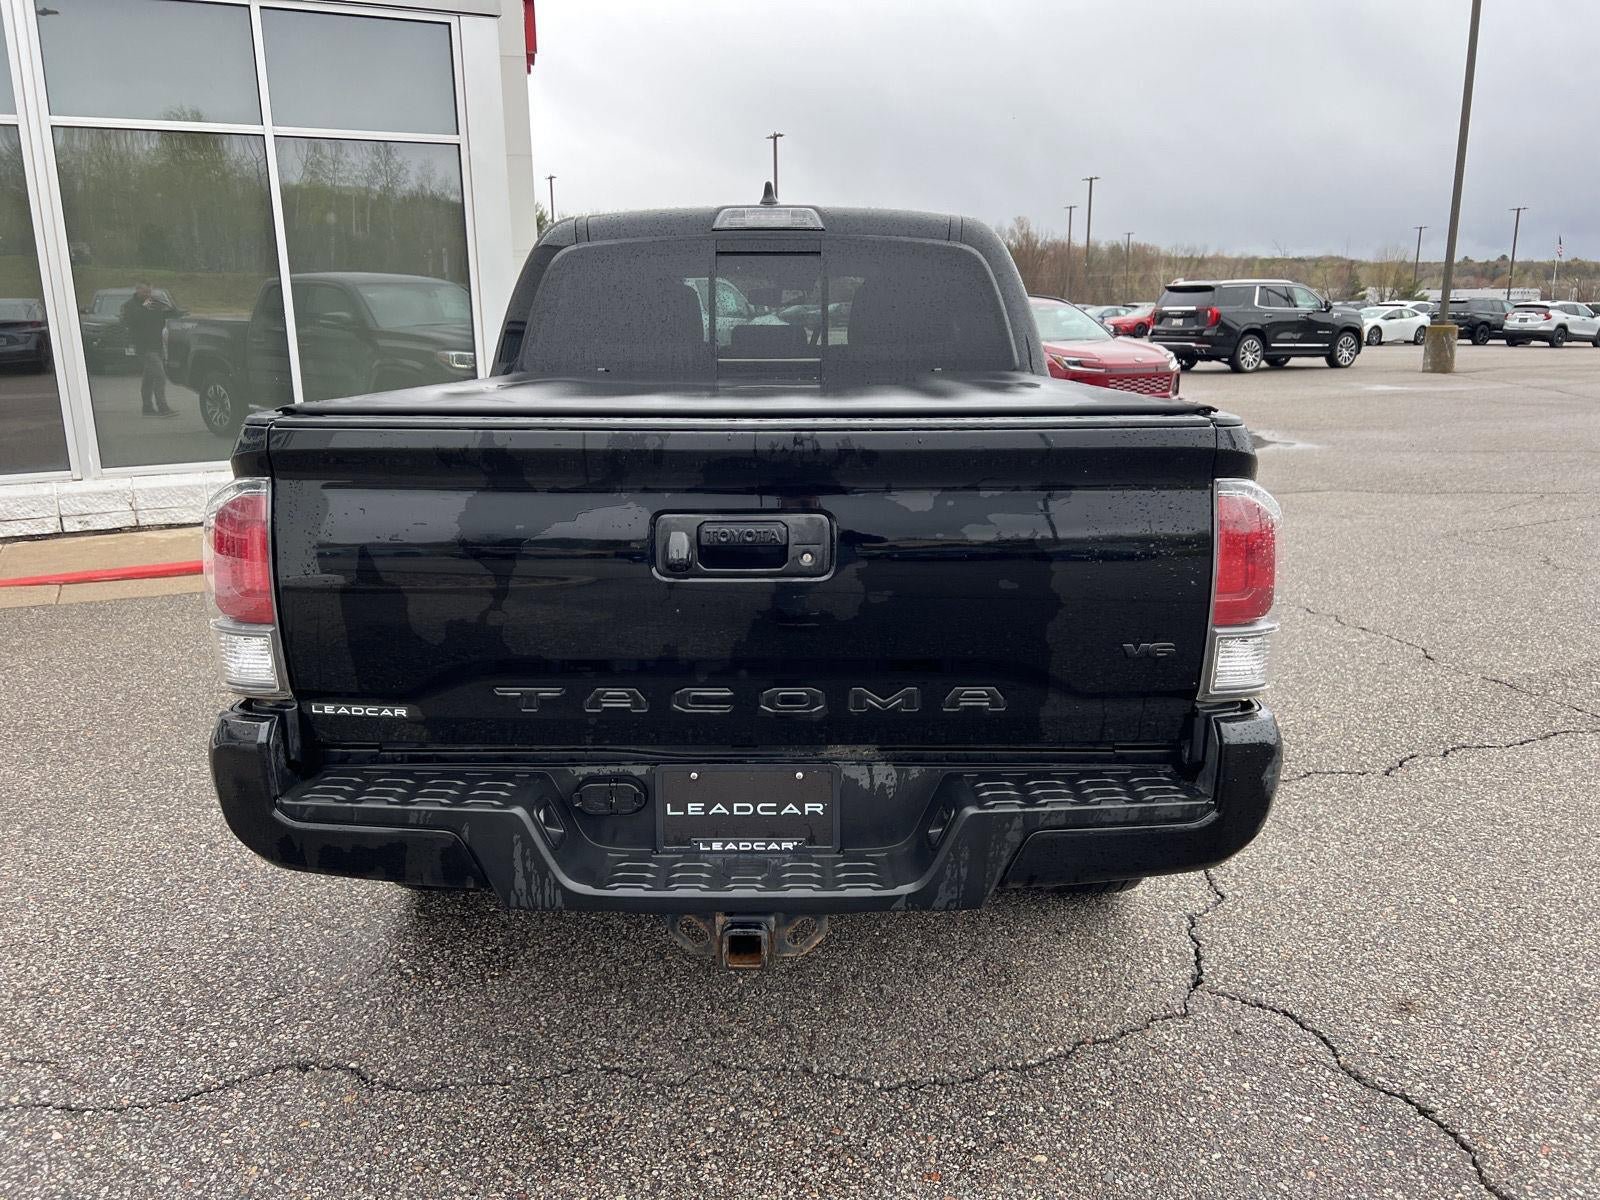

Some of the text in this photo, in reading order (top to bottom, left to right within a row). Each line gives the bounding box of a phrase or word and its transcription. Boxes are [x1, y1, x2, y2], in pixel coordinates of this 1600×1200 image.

[705, 528, 781, 544] TOYOTA
[1122, 642, 1176, 657] V6
[493, 686, 1007, 712] TACOMA
[311, 704, 407, 717] LEADCAR
